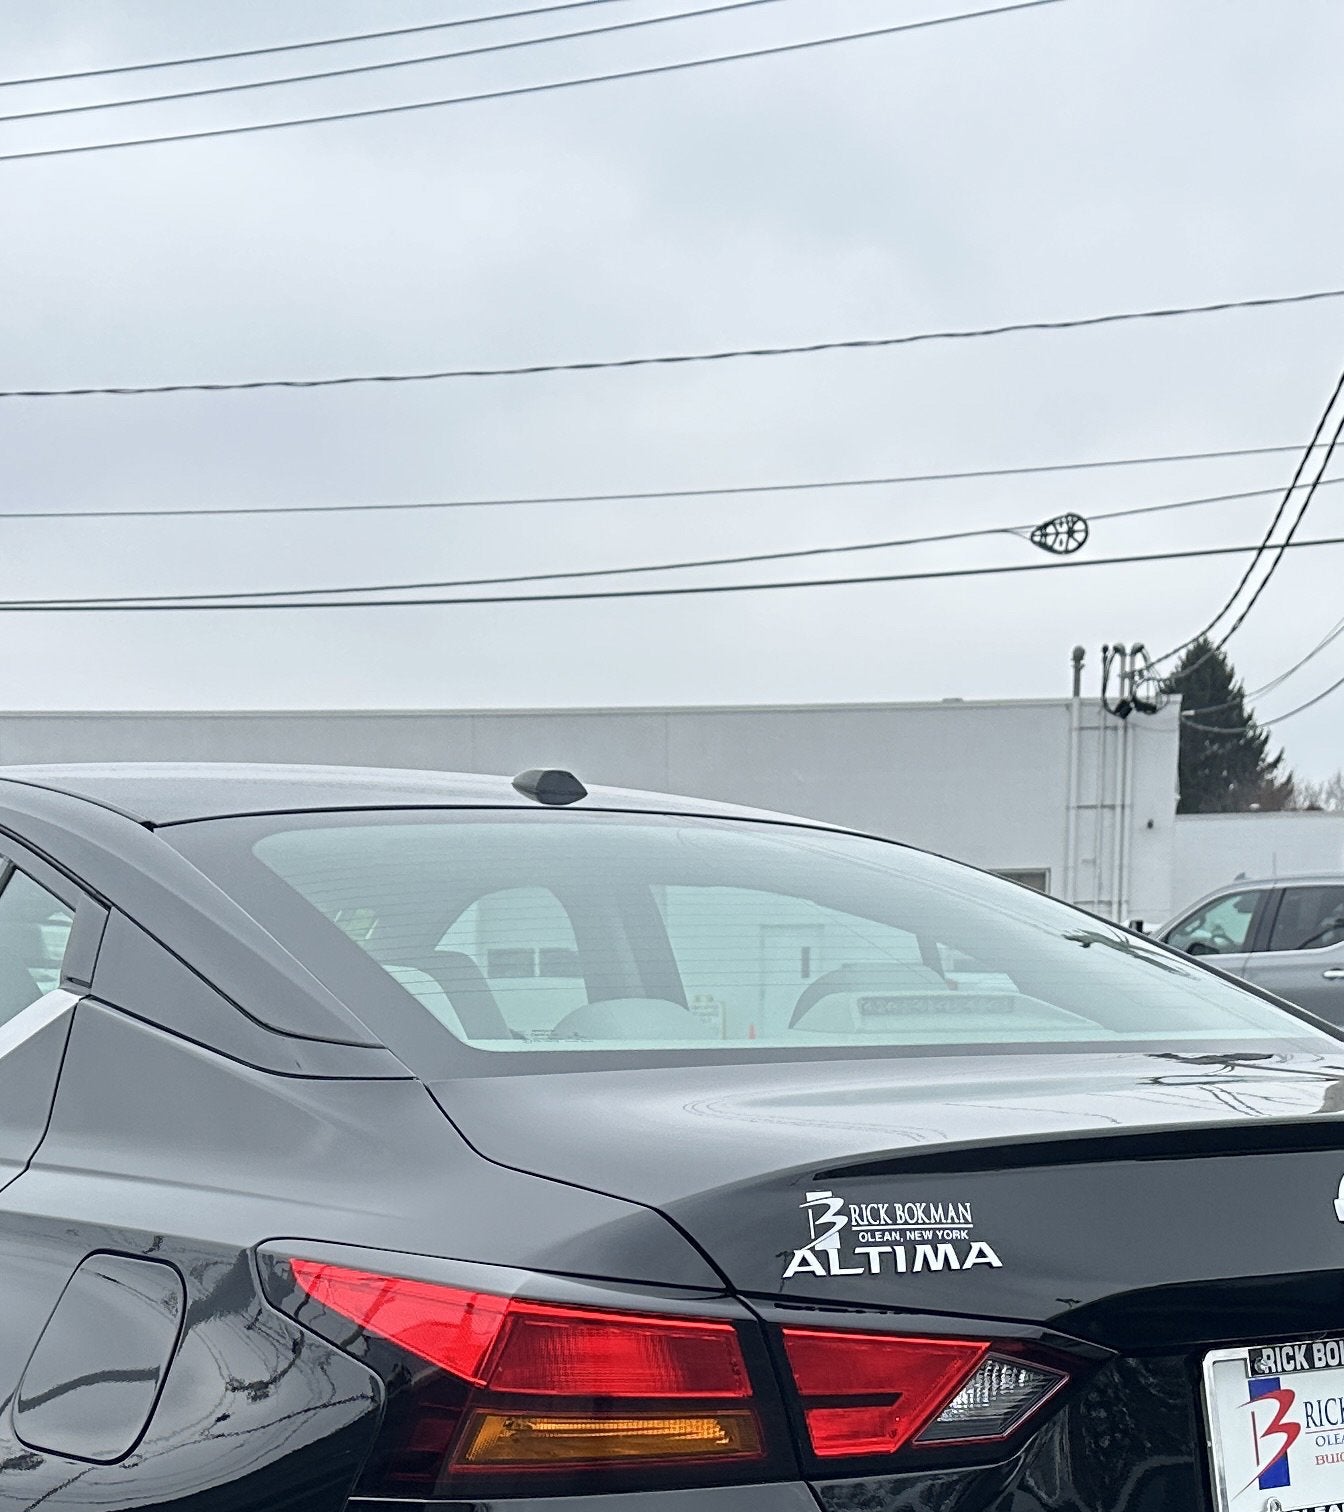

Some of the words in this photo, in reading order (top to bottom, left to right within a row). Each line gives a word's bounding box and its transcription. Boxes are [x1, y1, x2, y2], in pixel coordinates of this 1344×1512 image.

[849, 1204, 893, 1226] RICK
[894, 1202, 973, 1224] BOKMAN
[858, 1230, 905, 1243] OLEAN,
[906, 1229, 936, 1242] NEW
[936, 1229, 970, 1241] YORK
[782, 1241, 1003, 1279] ALTIMA
[1262, 1344, 1309, 1373] RICK
